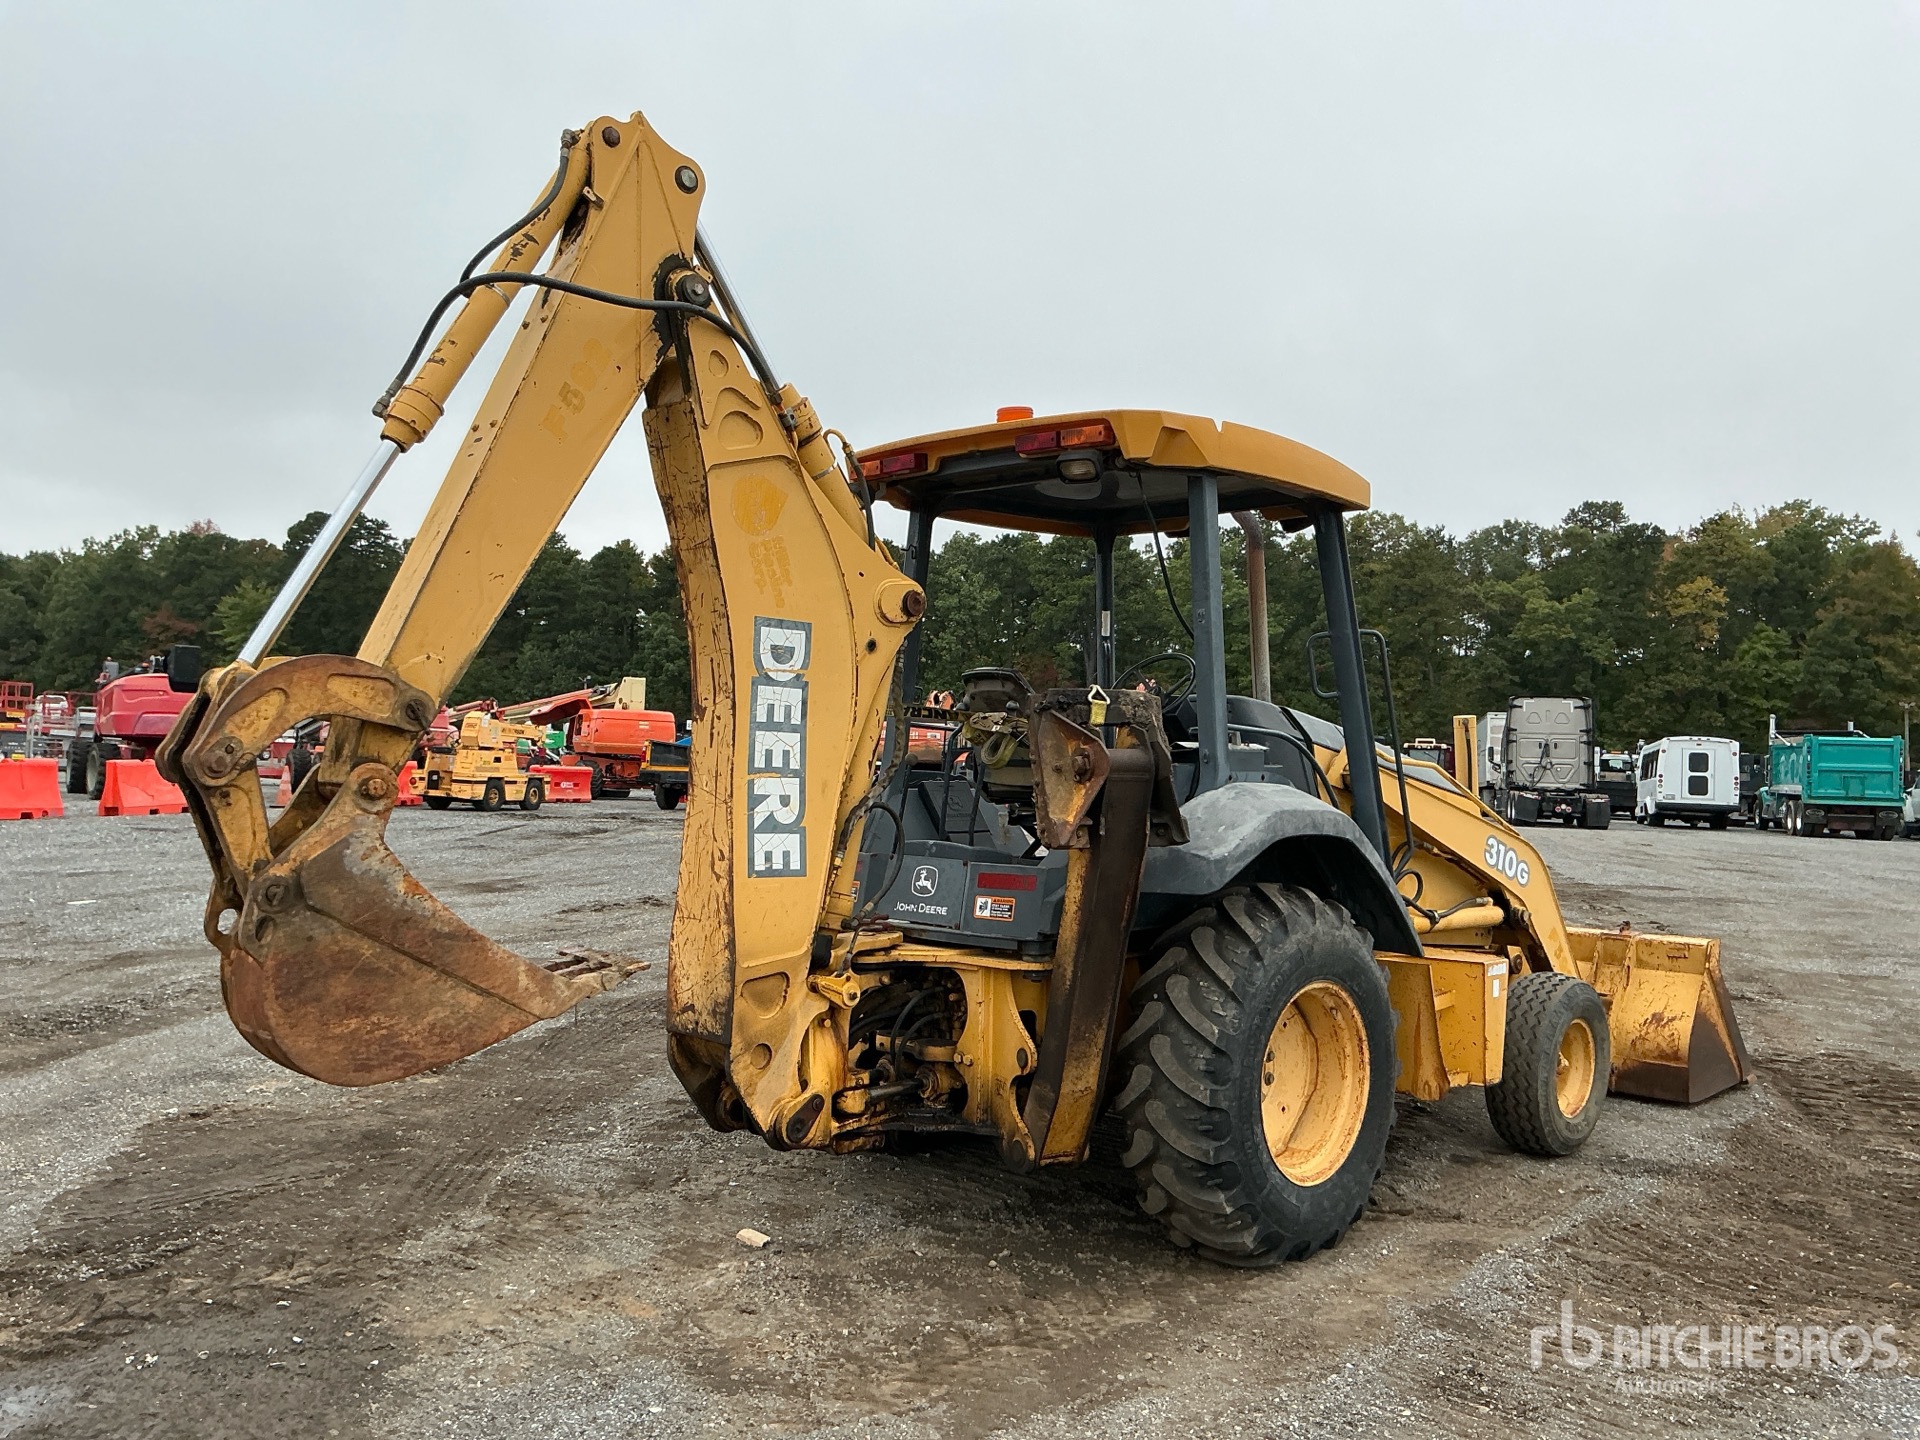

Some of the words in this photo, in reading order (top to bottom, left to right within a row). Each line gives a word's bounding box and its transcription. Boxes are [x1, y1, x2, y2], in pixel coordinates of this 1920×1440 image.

[753, 627, 805, 871] DEERE
[1485, 836, 1530, 886] 310G
[894, 901, 918, 912] JOHN
[918, 903, 948, 915] DEERE
